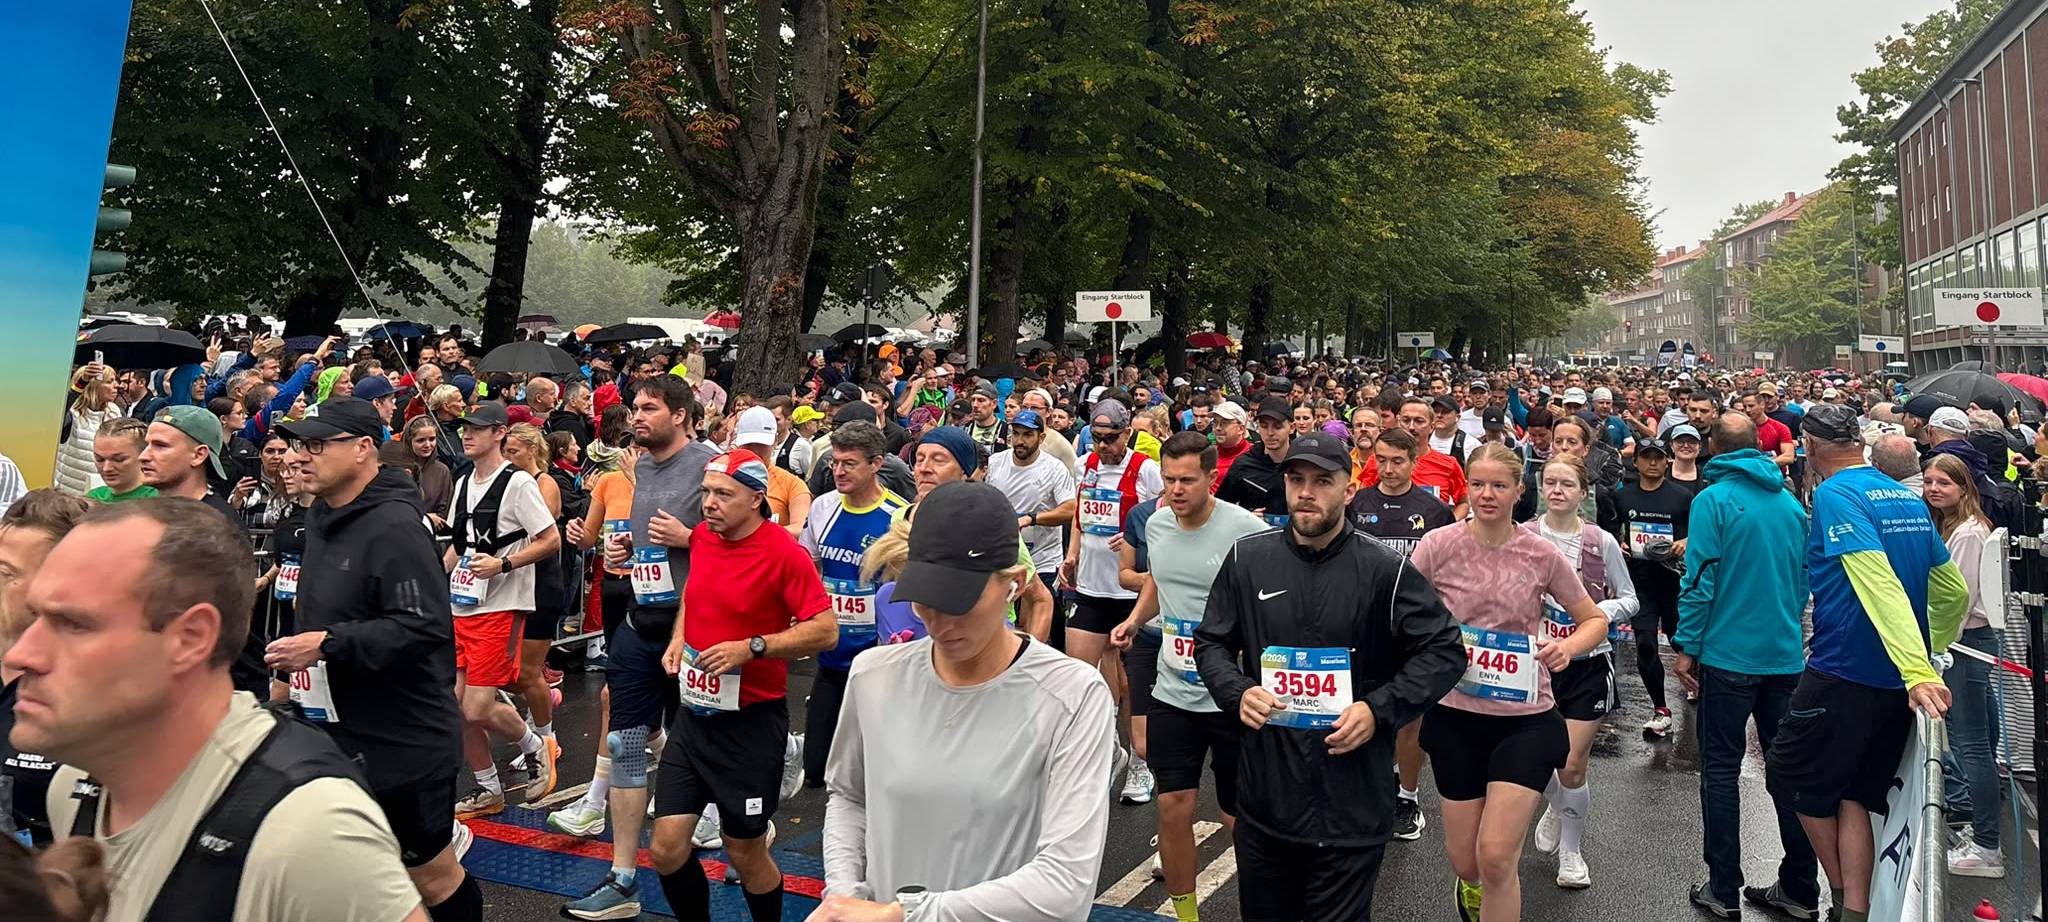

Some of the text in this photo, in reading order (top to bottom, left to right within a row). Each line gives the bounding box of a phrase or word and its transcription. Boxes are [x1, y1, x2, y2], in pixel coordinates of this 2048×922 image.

[1942, 290, 2033, 300] Eingang Startblock
[1083, 501, 1113, 516] 3302
[633, 564, 661, 582] 4119
[830, 595, 866, 614] 145
[1174, 637, 1196, 657] 97
[1267, 653, 1287, 663] 2026
[1466, 647, 1518, 674] 1446
[686, 669, 721, 695] 949
[1273, 671, 1337, 697] 3594
[1479, 671, 1501, 681] ENYA
[686, 688, 721, 704] SEBASTIAN
[1292, 698, 1320, 708] MARC
